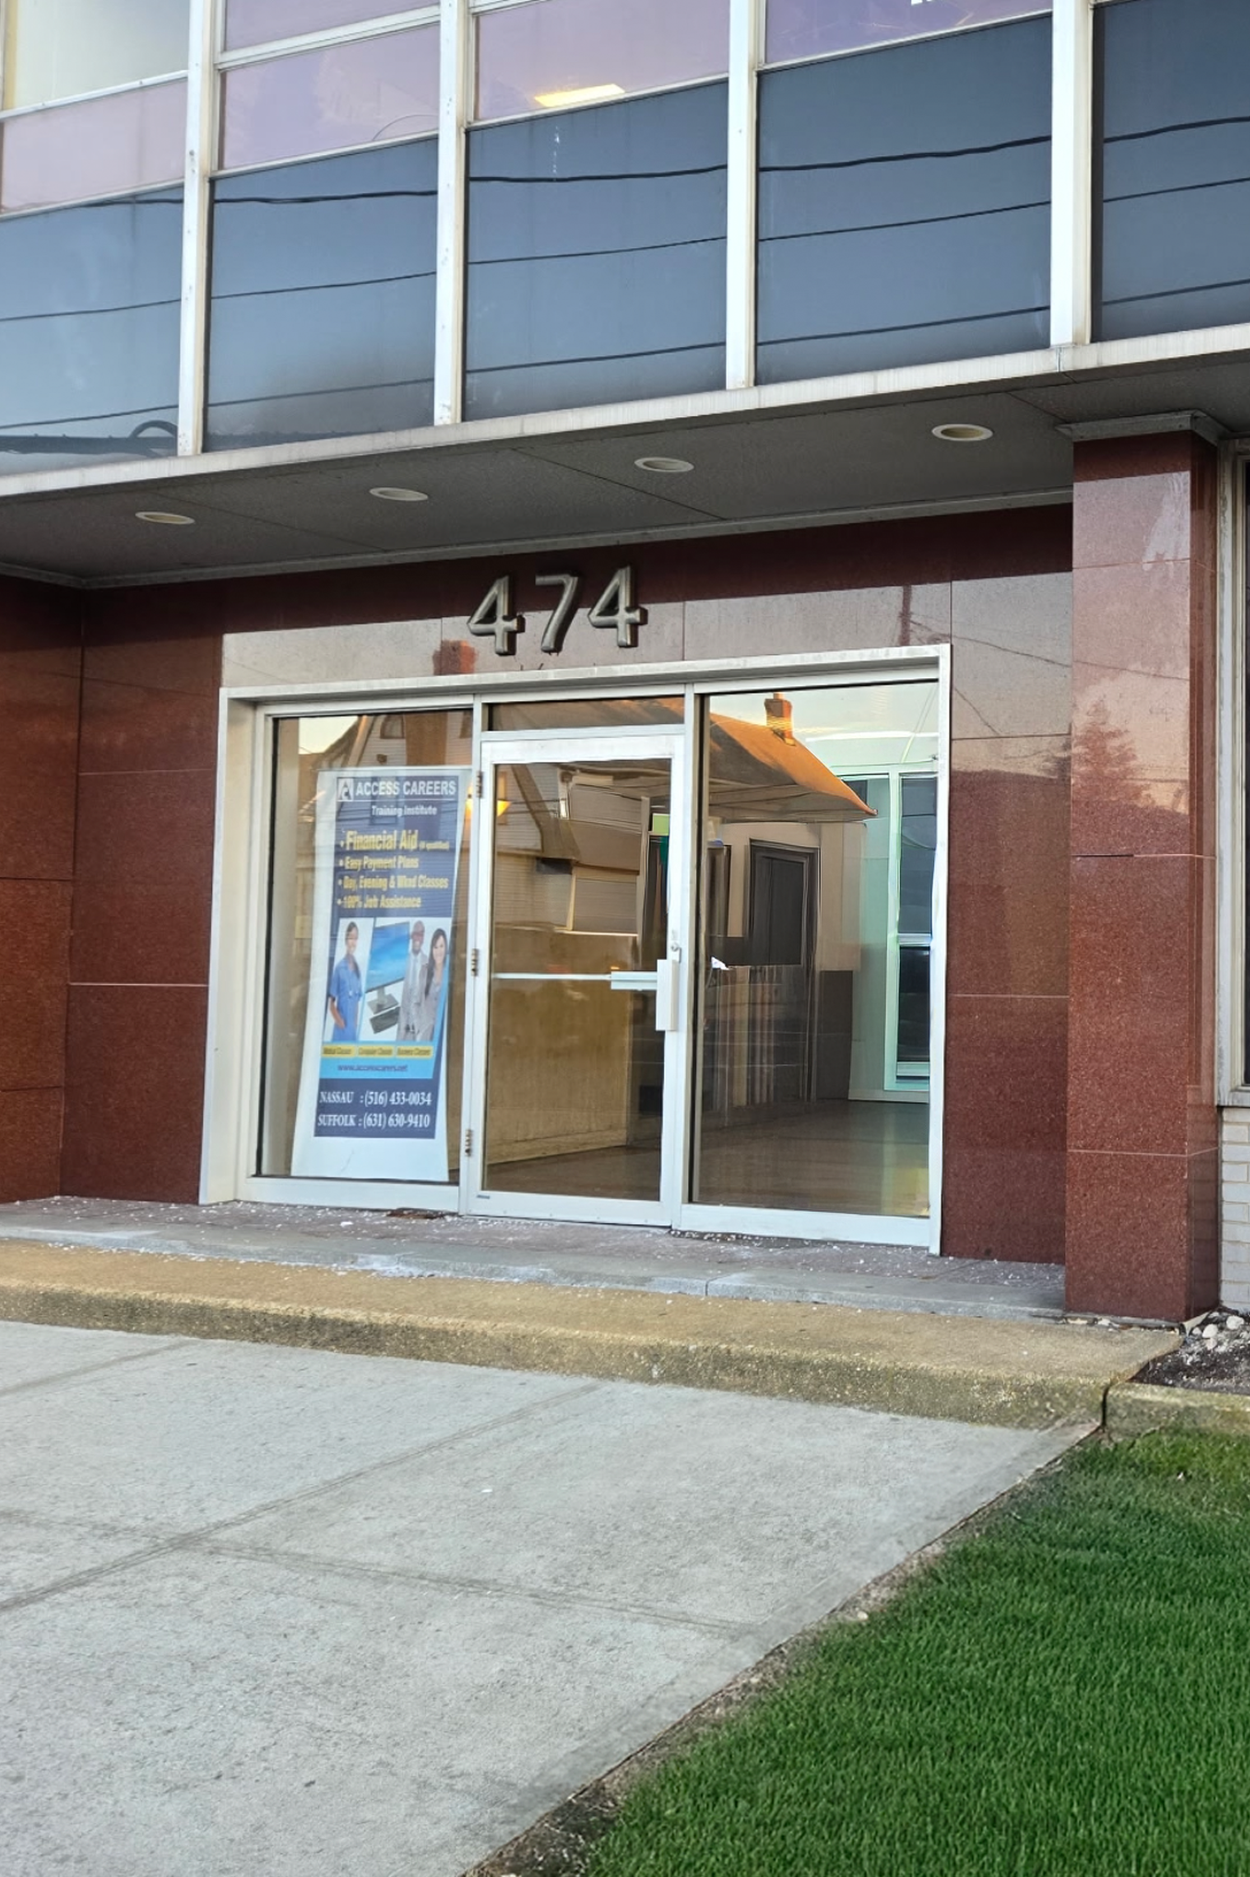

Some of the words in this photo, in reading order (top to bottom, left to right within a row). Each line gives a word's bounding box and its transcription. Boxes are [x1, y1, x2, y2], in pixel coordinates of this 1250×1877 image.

[467, 566, 645, 656] 474
[355, 780, 400, 796] ACCESS
[402, 780, 457, 796] CAREERS
[372, 805, 402, 817] Training
[403, 805, 437, 816] Institute
[346, 830, 397, 850] Financial
[400, 830, 418, 850] Aid
[345, 856, 360, 871] Easy
[363, 855, 396, 871] Payment
[397, 855, 419, 869] Plans
[360, 875, 387, 891] Evening
[418, 875, 449, 889] Classes
[364, 895, 378, 908] Job
[380, 894, 421, 908] Assistance
[319, 1091, 355, 1104] NASSAU
[389, 1091, 432, 1106] 433-0034
[318, 1114, 357, 1127] SUFFOLK
[388, 1113, 430, 1128] 630-9410
